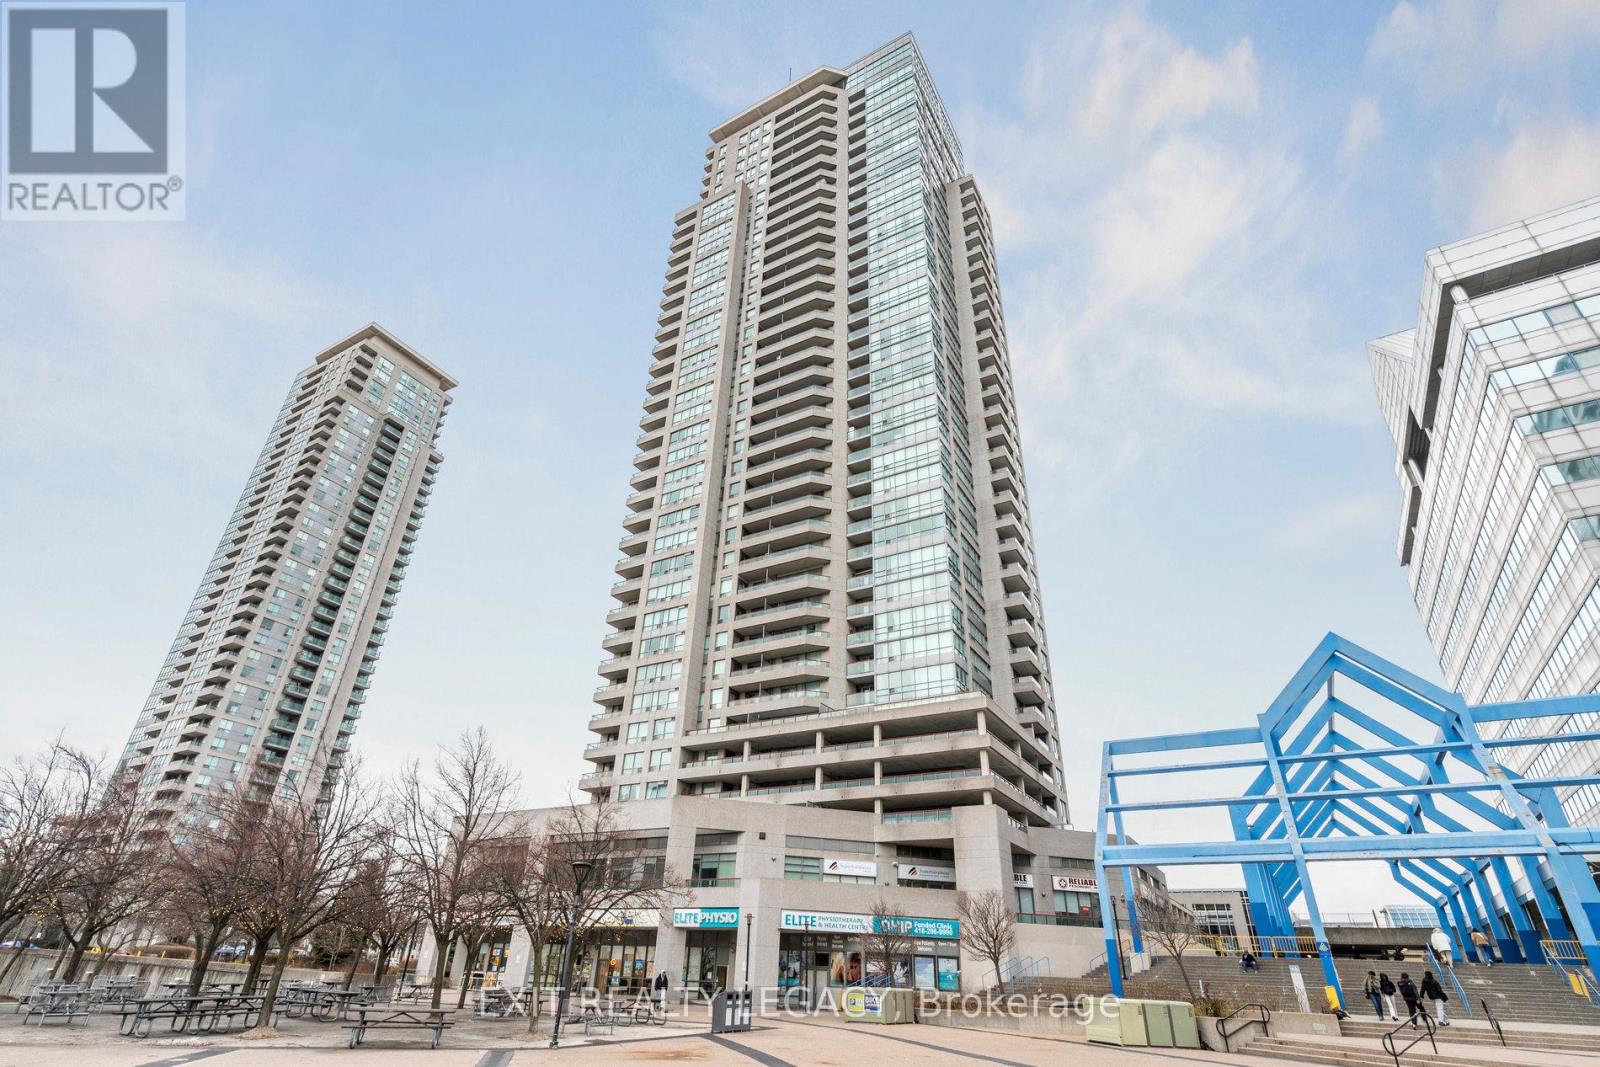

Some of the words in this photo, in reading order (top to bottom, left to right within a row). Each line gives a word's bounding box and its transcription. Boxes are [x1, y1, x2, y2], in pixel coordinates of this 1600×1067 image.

[1069, 878, 1097, 887] RELIABL
[785, 914, 817, 927] ELITE
[818, 915, 864, 924] PHYSIOTHERAPY
[914, 921, 936, 929] Funded
